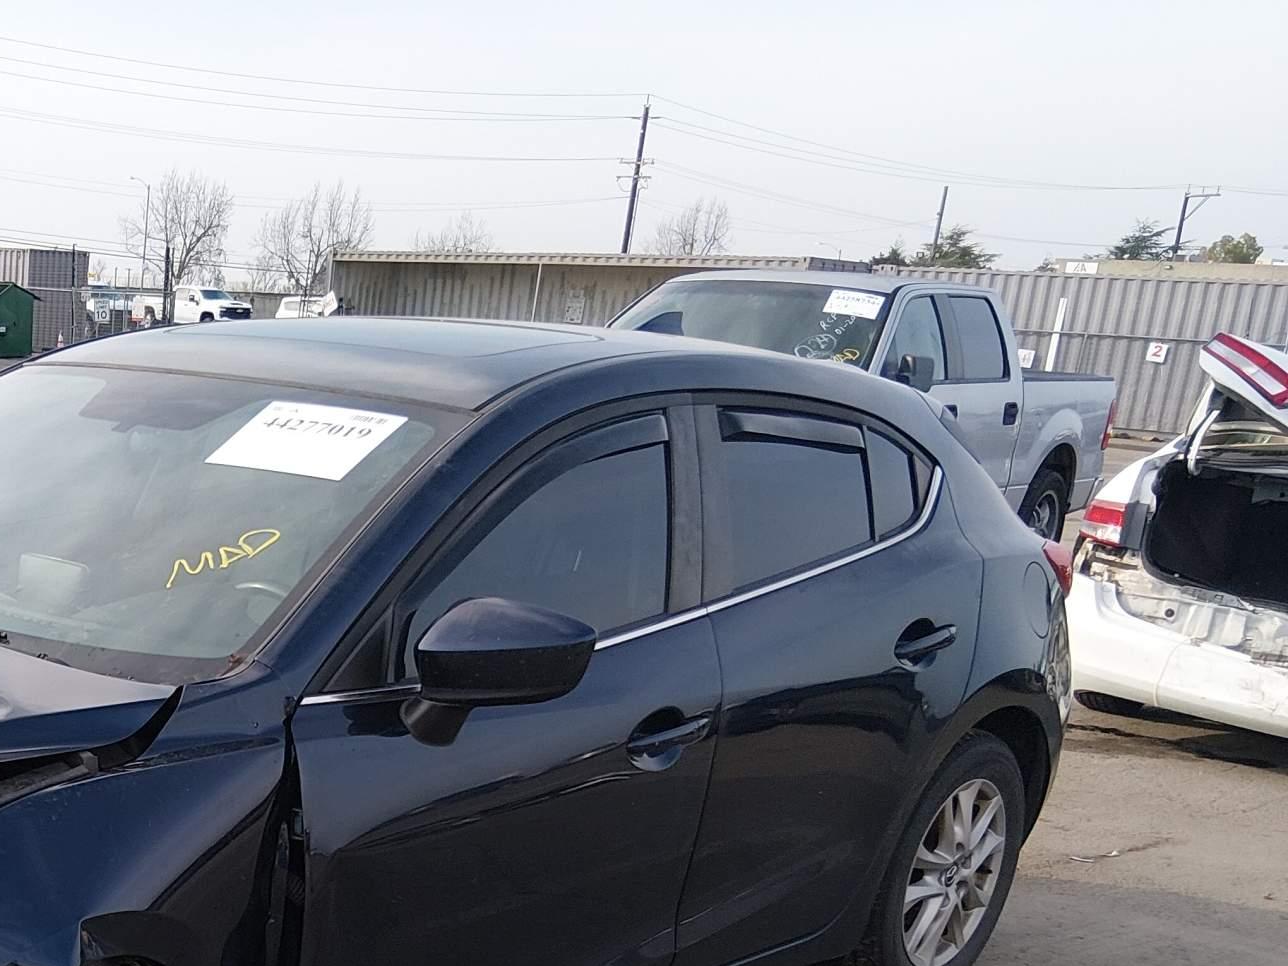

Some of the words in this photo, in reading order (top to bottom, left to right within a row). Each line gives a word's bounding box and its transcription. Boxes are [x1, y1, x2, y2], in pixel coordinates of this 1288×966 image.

[96, 310, 107, 320] 10
[1151, 345, 1162, 358] 2
[263, 417, 373, 439] 44277019
[165, 528, 280, 589] MAD
